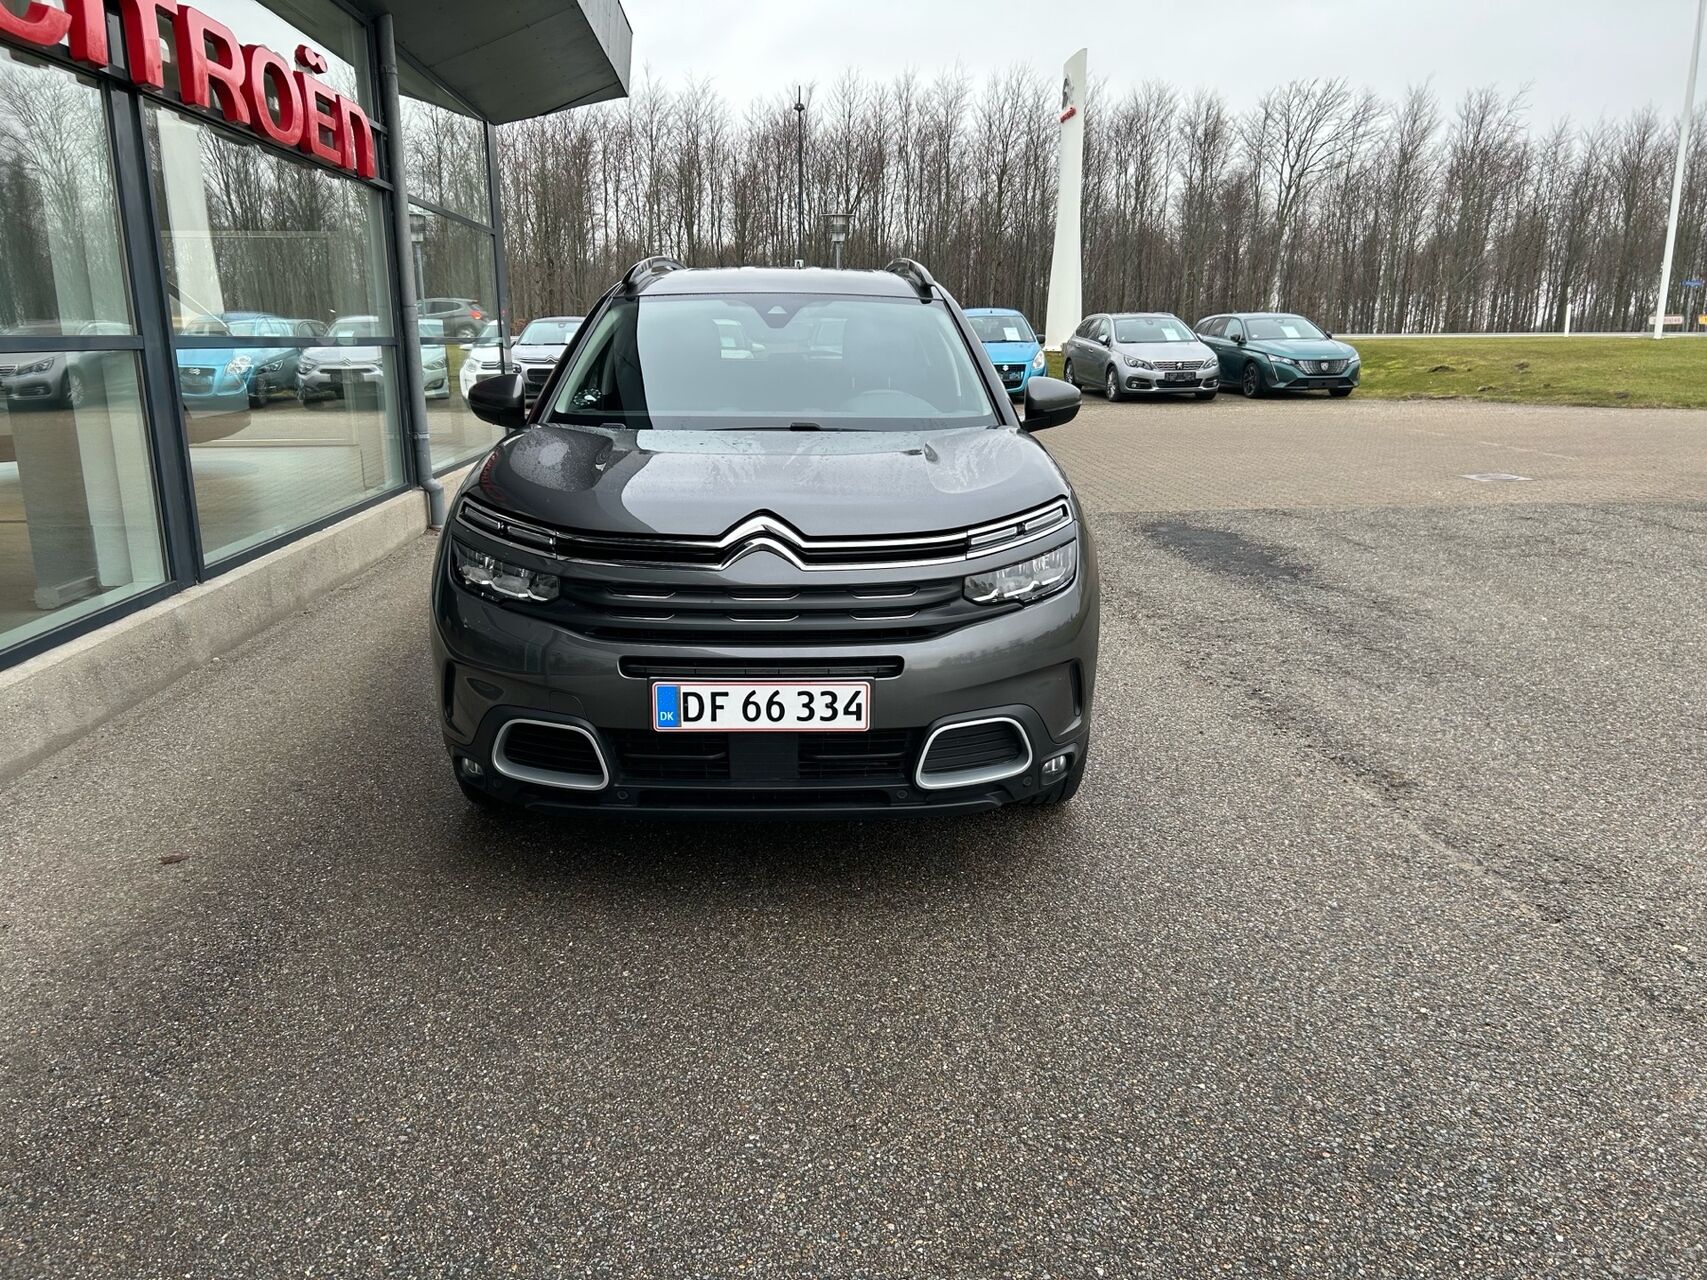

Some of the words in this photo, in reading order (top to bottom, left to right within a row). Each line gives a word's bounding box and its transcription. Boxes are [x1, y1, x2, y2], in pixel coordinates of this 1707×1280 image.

[659, 711, 675, 721] DK
[682, 691, 729, 723] DF
[742, 690, 786, 722] 66
[796, 690, 863, 722] 334
